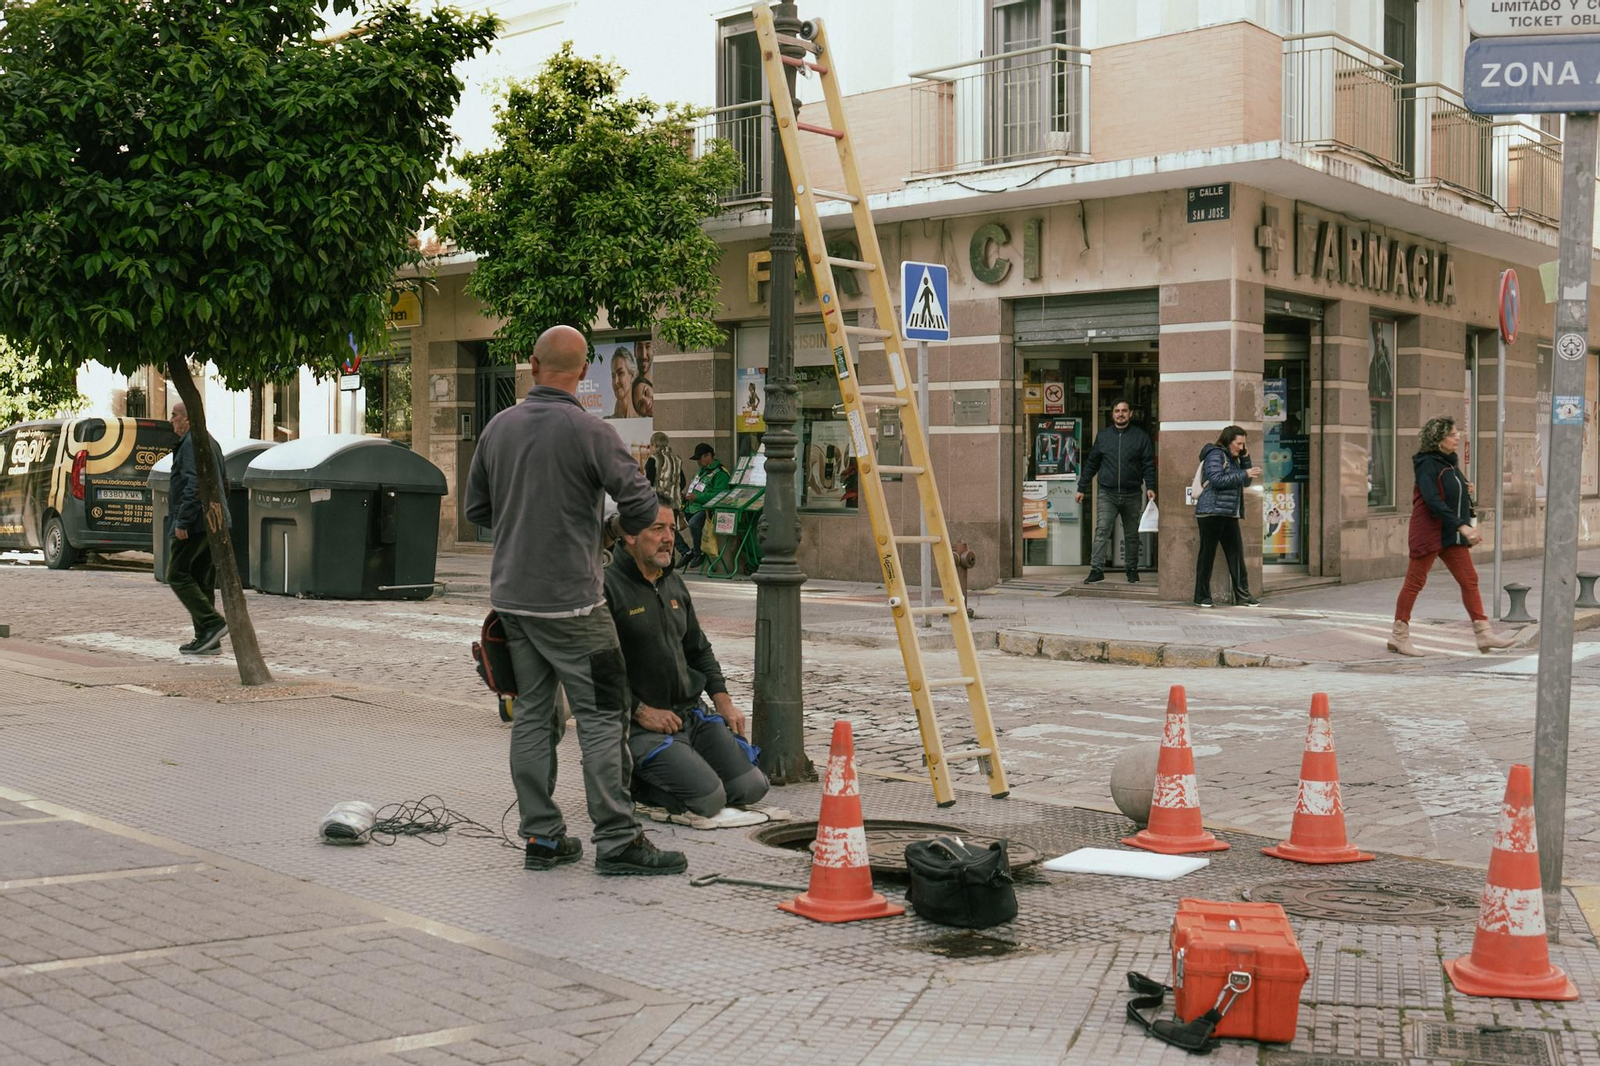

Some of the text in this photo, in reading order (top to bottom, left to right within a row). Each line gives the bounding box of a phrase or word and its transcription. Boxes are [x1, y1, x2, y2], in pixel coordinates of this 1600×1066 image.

[1491, 0, 1600, 13] LIMITADO Y C
[1509, 15, 1563, 27] TICKET
[1481, 61, 1581, 88] ZONA
[1199, 186, 1224, 197] CALLE
[1192, 207, 1225, 220] SAN JOSE
[1296, 208, 1457, 306] FARMACIA
[799, 332, 828, 350] ISDIN
[1276, 493, 1295, 502] OK
